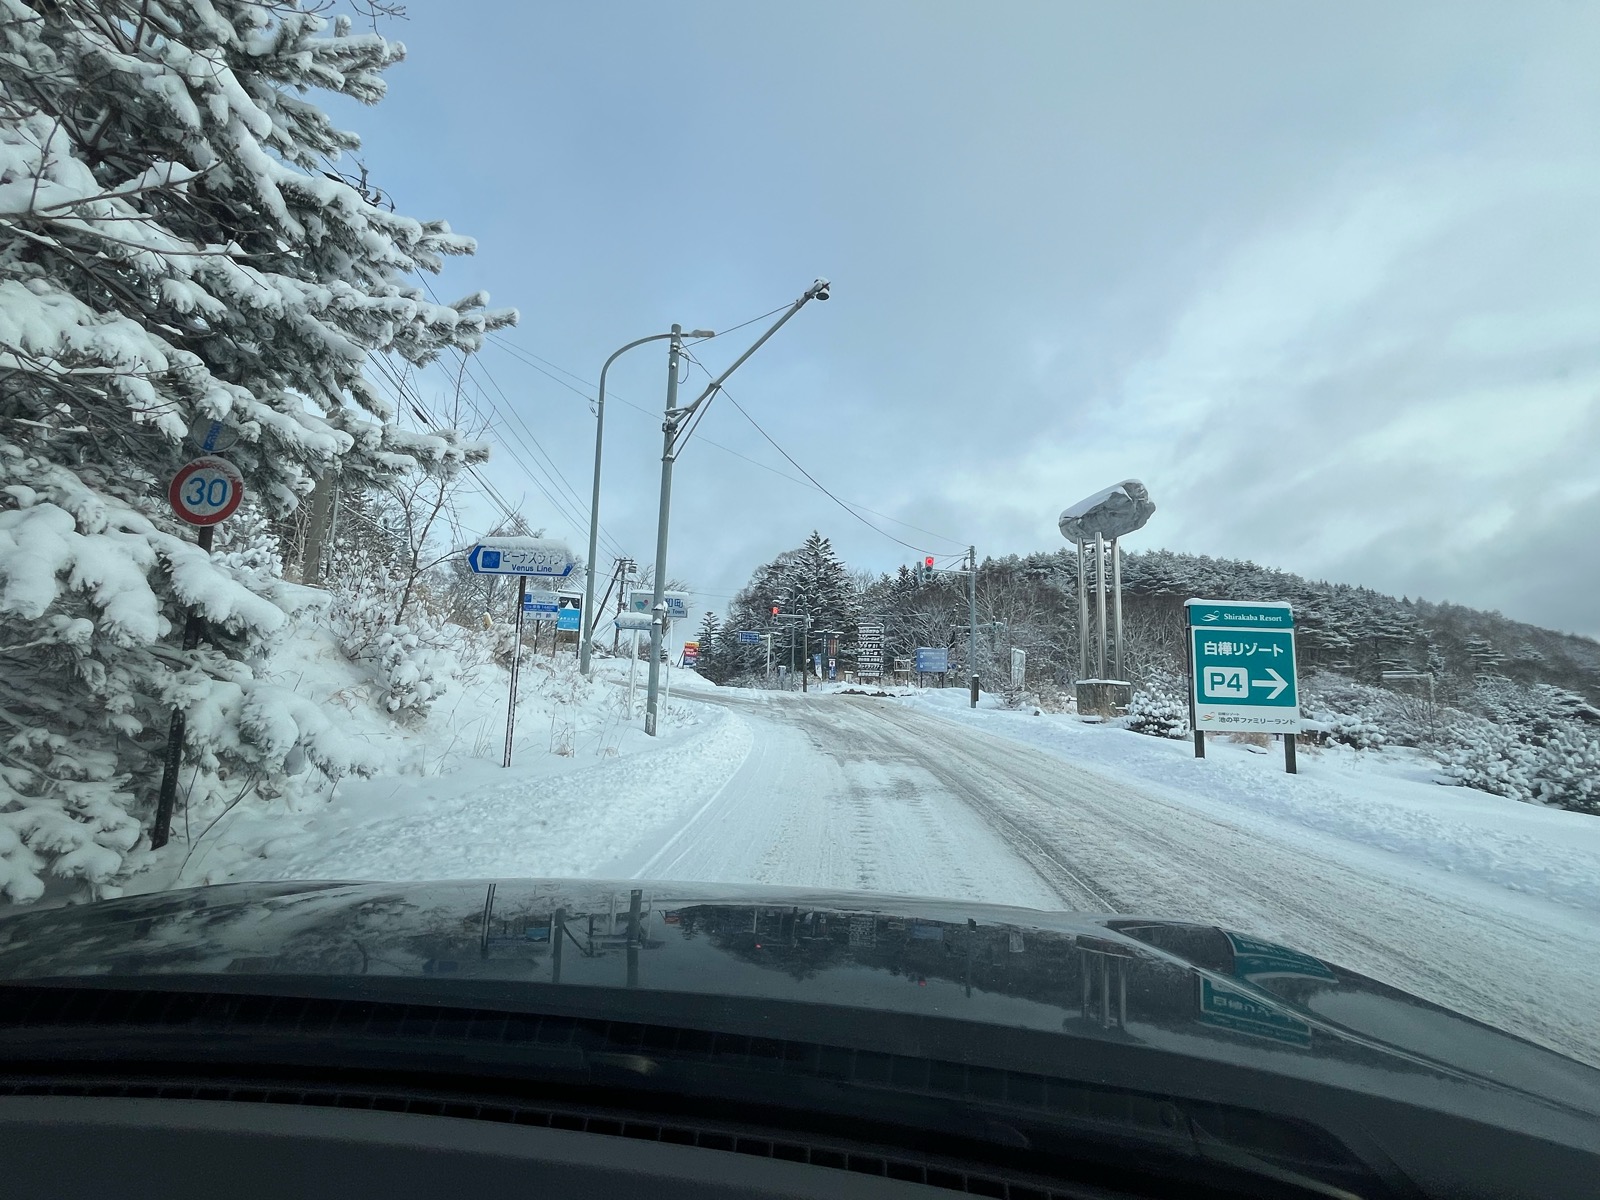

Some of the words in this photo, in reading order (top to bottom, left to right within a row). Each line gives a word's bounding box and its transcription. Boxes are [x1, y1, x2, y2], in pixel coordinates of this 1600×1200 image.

[186, 477, 228, 507] 30
[511, 564, 534, 572] Venus
[536, 565, 553, 573] Line
[664, 598, 684, 609] 和町
[1223, 613, 1258, 622] Shirakaba
[1259, 614, 1282, 622] Resort
[1203, 641, 1284, 658] 白樺リゾート
[1210, 672, 1243, 692] P4
[1218, 716, 1296, 726] 池の平ファミリーランド
